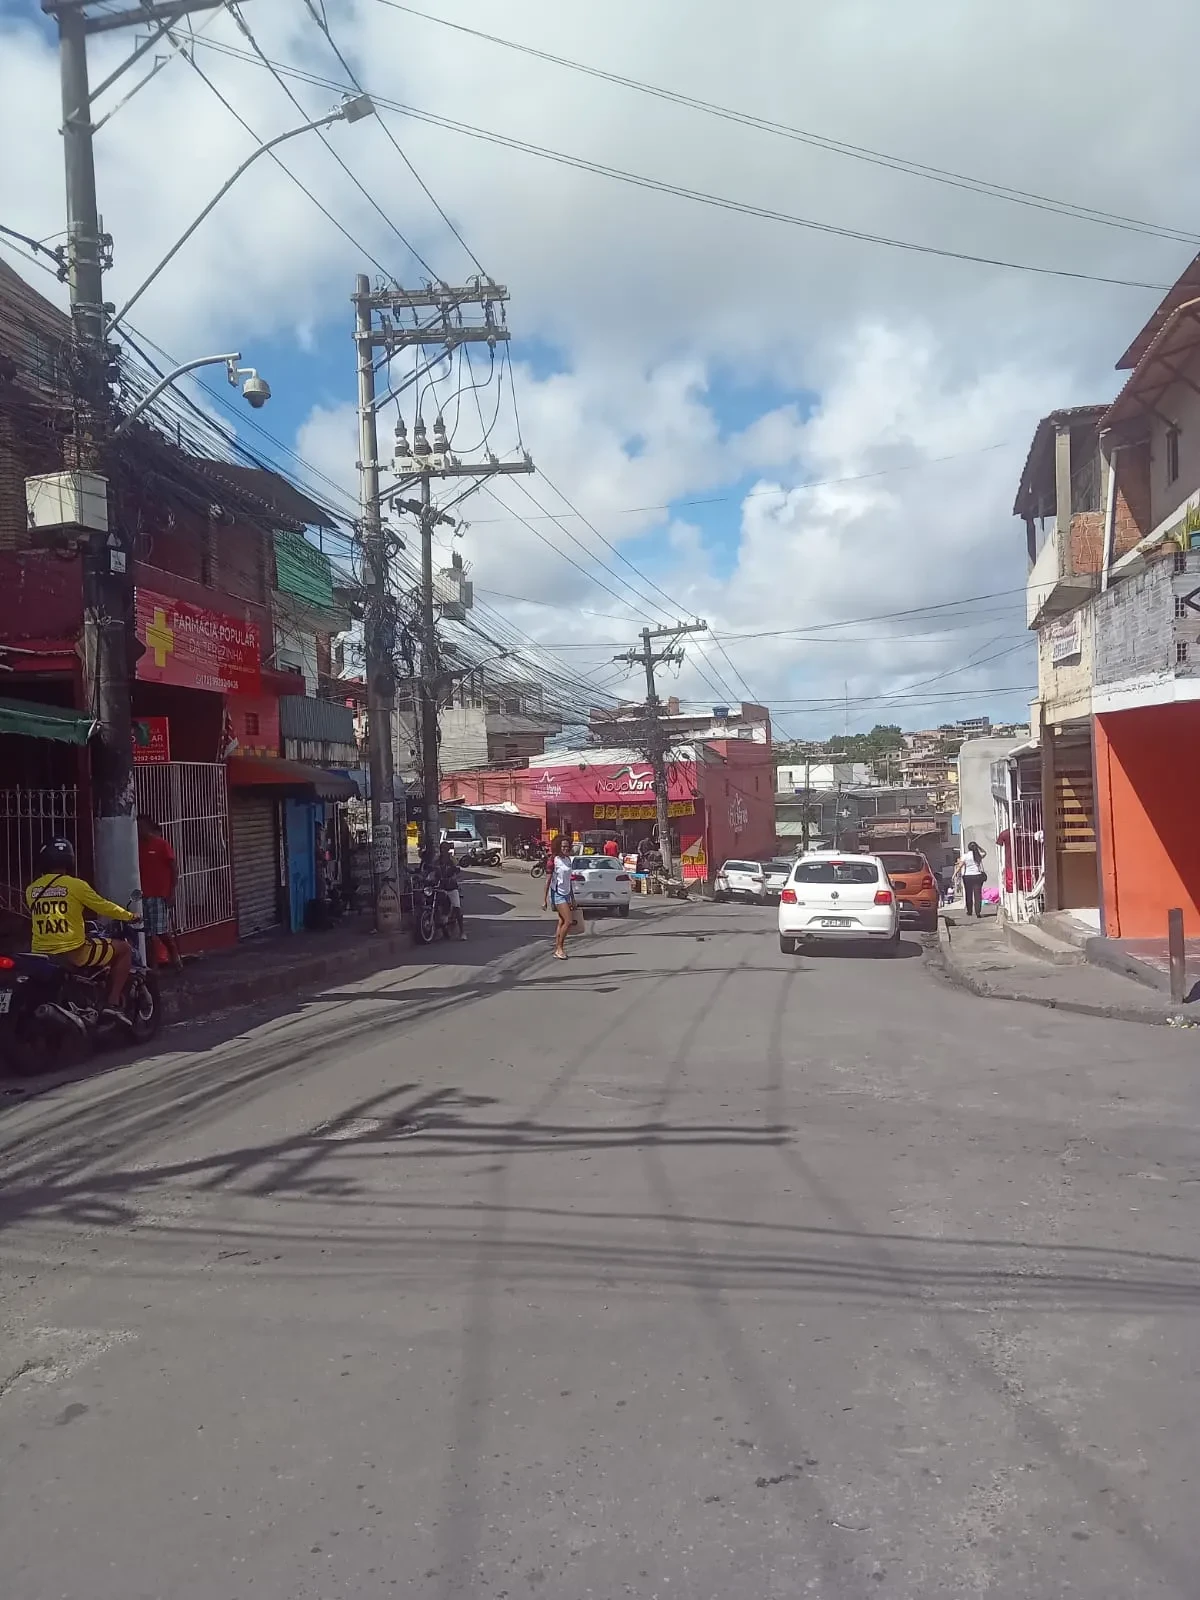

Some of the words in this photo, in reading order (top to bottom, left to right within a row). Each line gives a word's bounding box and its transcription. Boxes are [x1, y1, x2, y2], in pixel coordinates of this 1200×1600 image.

[219, 624, 255, 648] POPULAR
[189, 638, 201, 654] DA
[32, 900, 68, 915] MOTO
[37, 916, 69, 934] TÁXI
